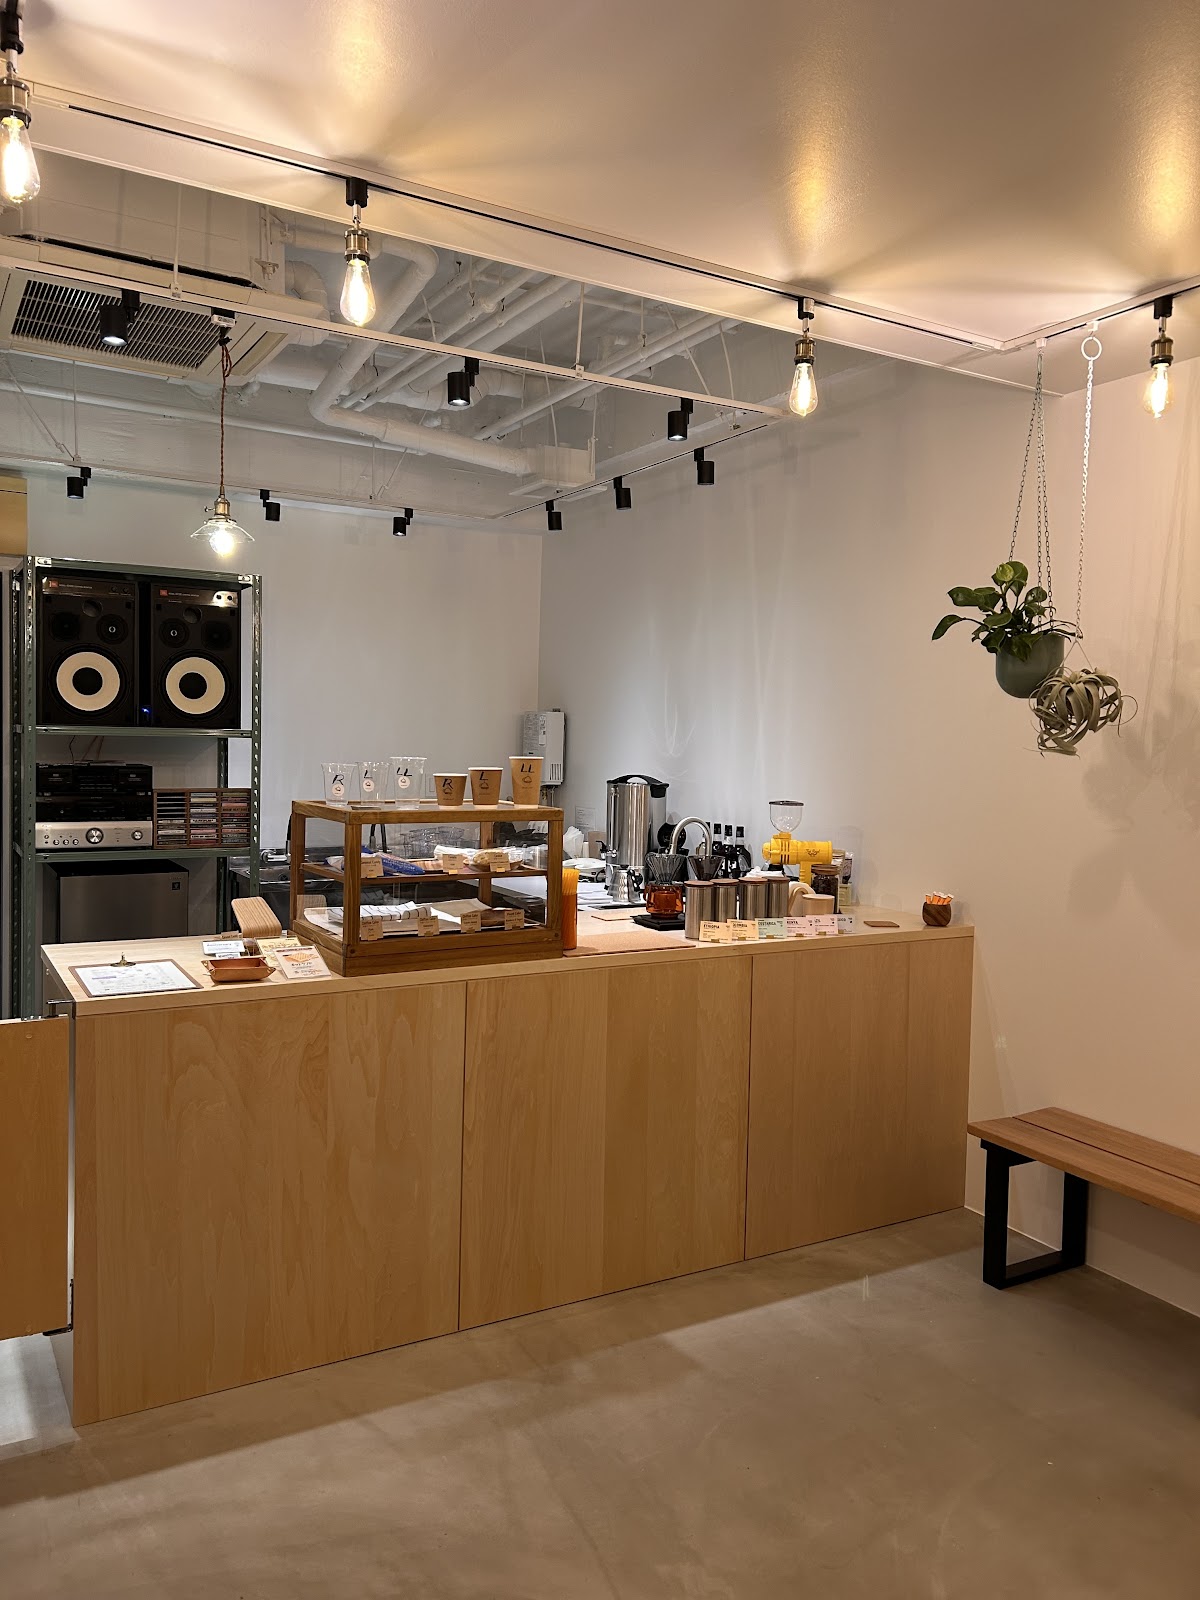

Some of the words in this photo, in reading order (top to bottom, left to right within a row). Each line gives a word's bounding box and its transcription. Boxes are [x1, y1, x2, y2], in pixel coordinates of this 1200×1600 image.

[363, 769, 373, 778] L
[396, 766, 413, 777] LL
[520, 763, 535, 774] LL
[332, 774, 344, 786] R
[479, 771, 489, 781] L
[442, 778, 454, 789] R
